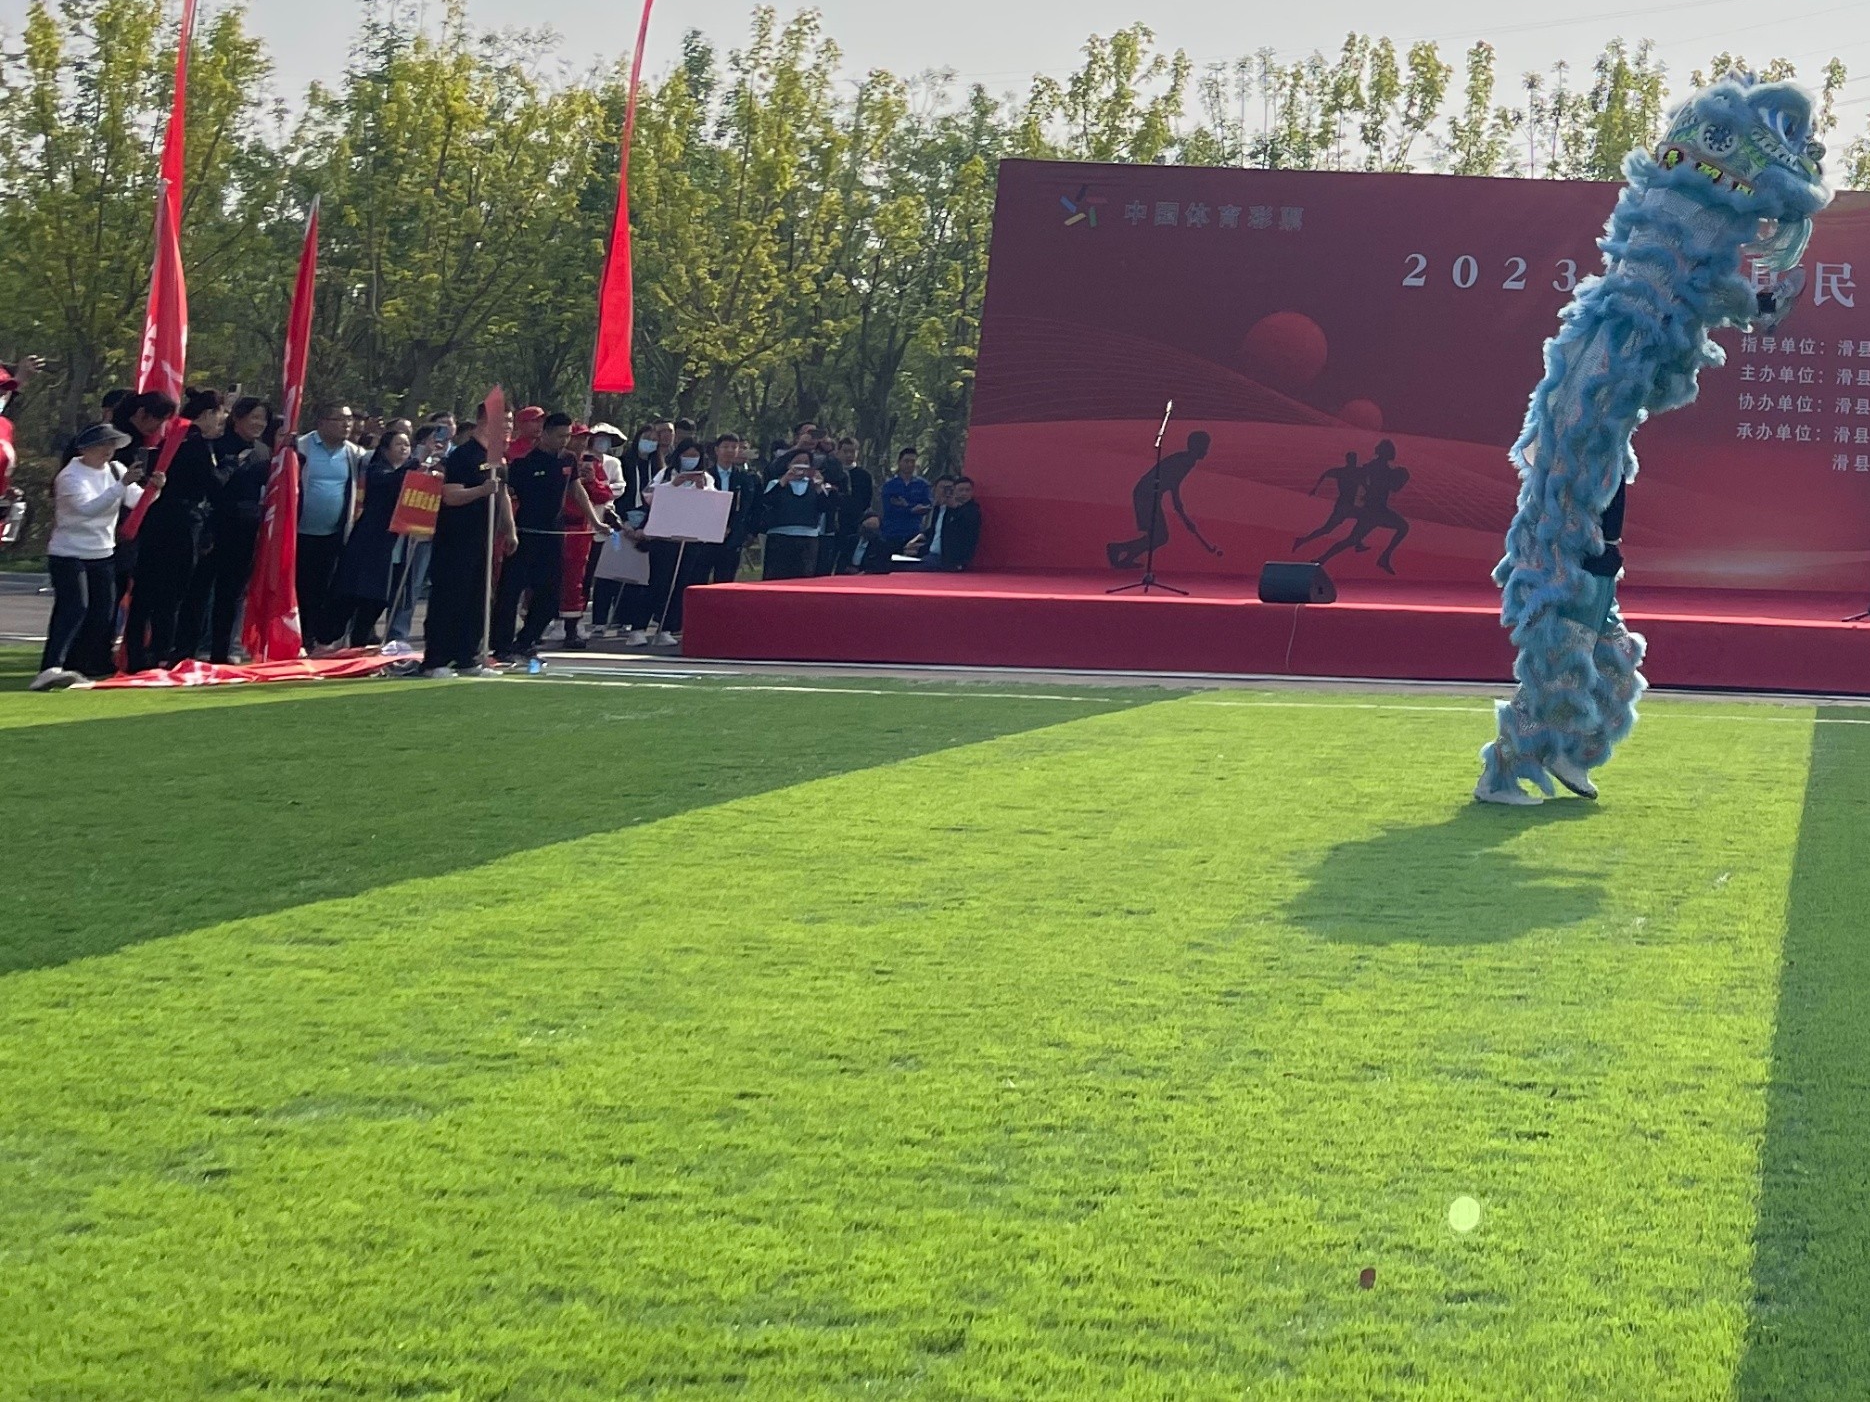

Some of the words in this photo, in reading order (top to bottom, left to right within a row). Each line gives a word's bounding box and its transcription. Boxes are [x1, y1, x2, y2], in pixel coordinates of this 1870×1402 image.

[1124, 200, 1304, 231] 中国体育彩票
